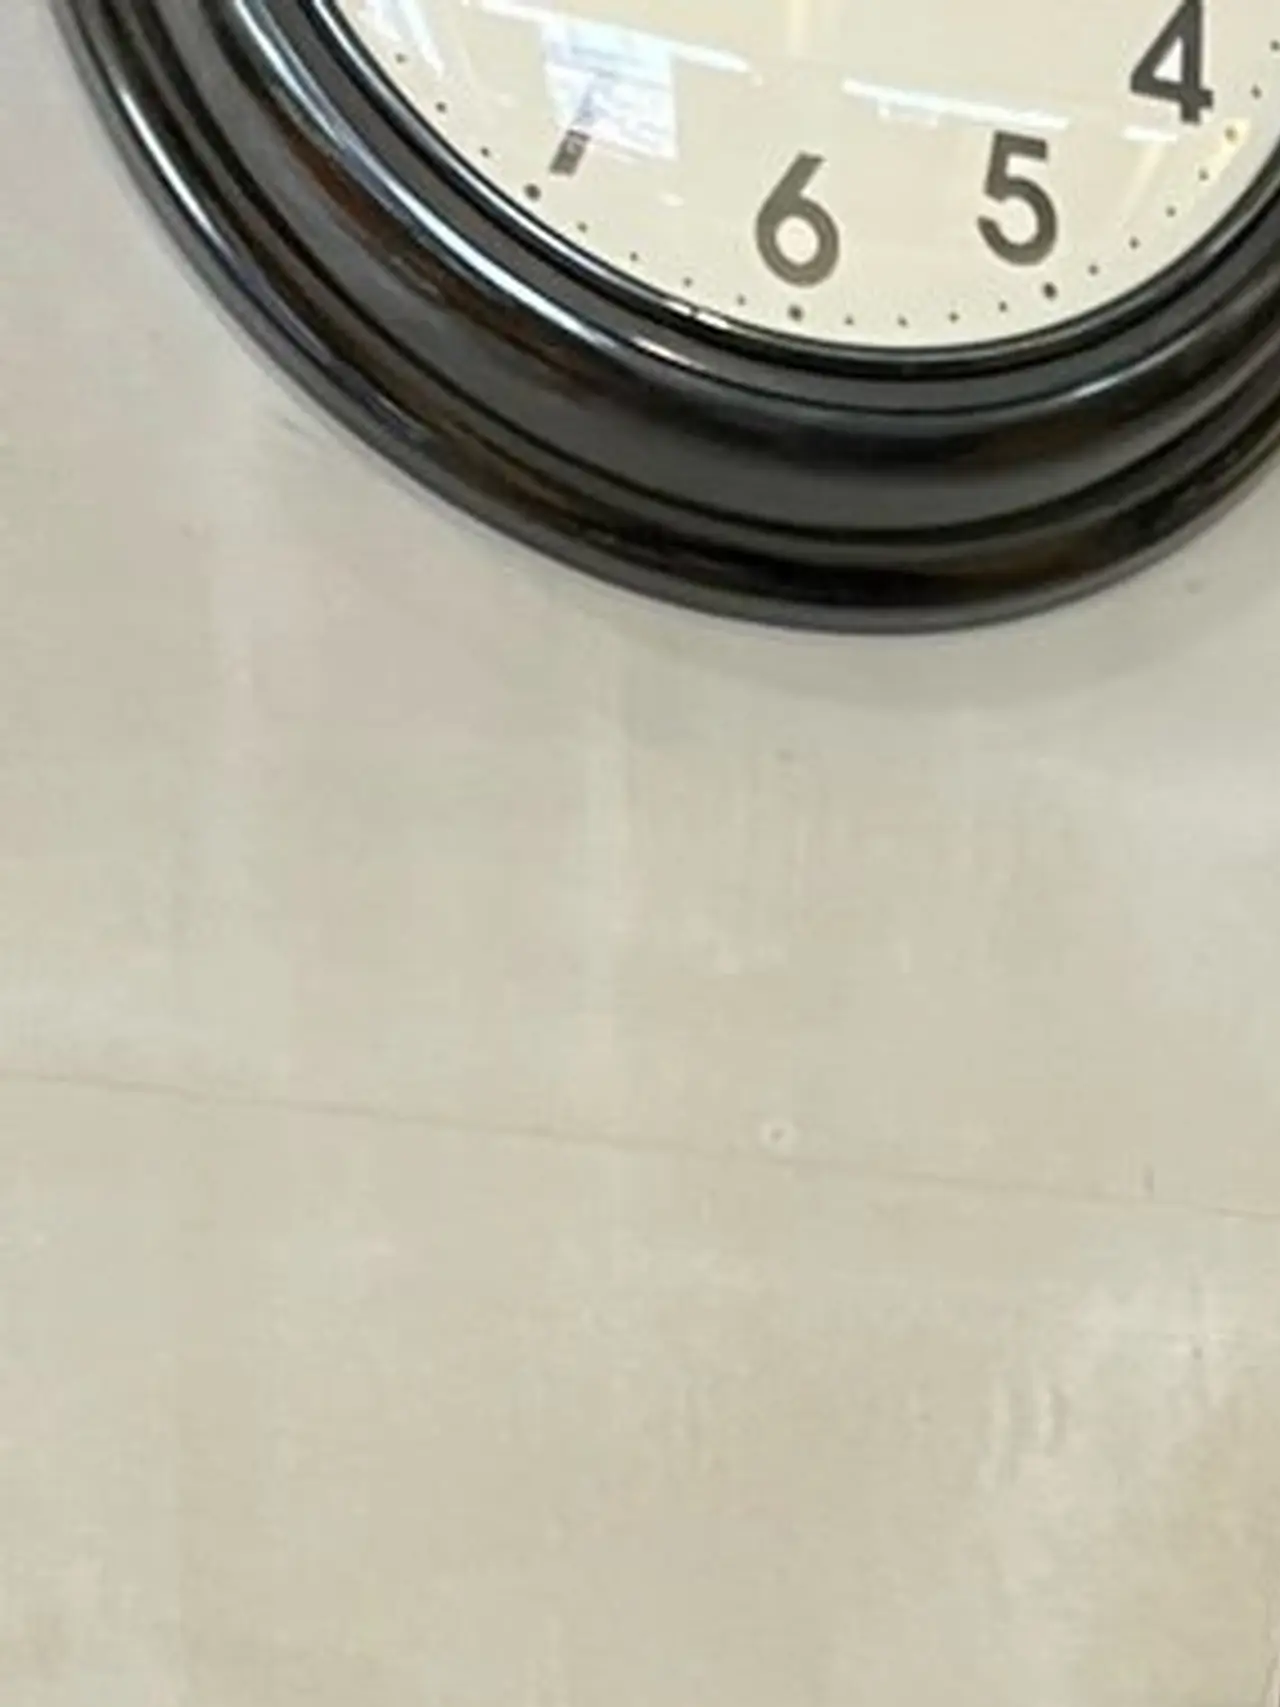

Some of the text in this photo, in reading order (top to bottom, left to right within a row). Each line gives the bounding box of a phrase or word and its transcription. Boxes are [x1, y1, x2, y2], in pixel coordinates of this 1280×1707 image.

[1129, 0, 1214, 125] 4
[755, 152, 840, 288] 6
[976, 129, 1058, 266] 5
